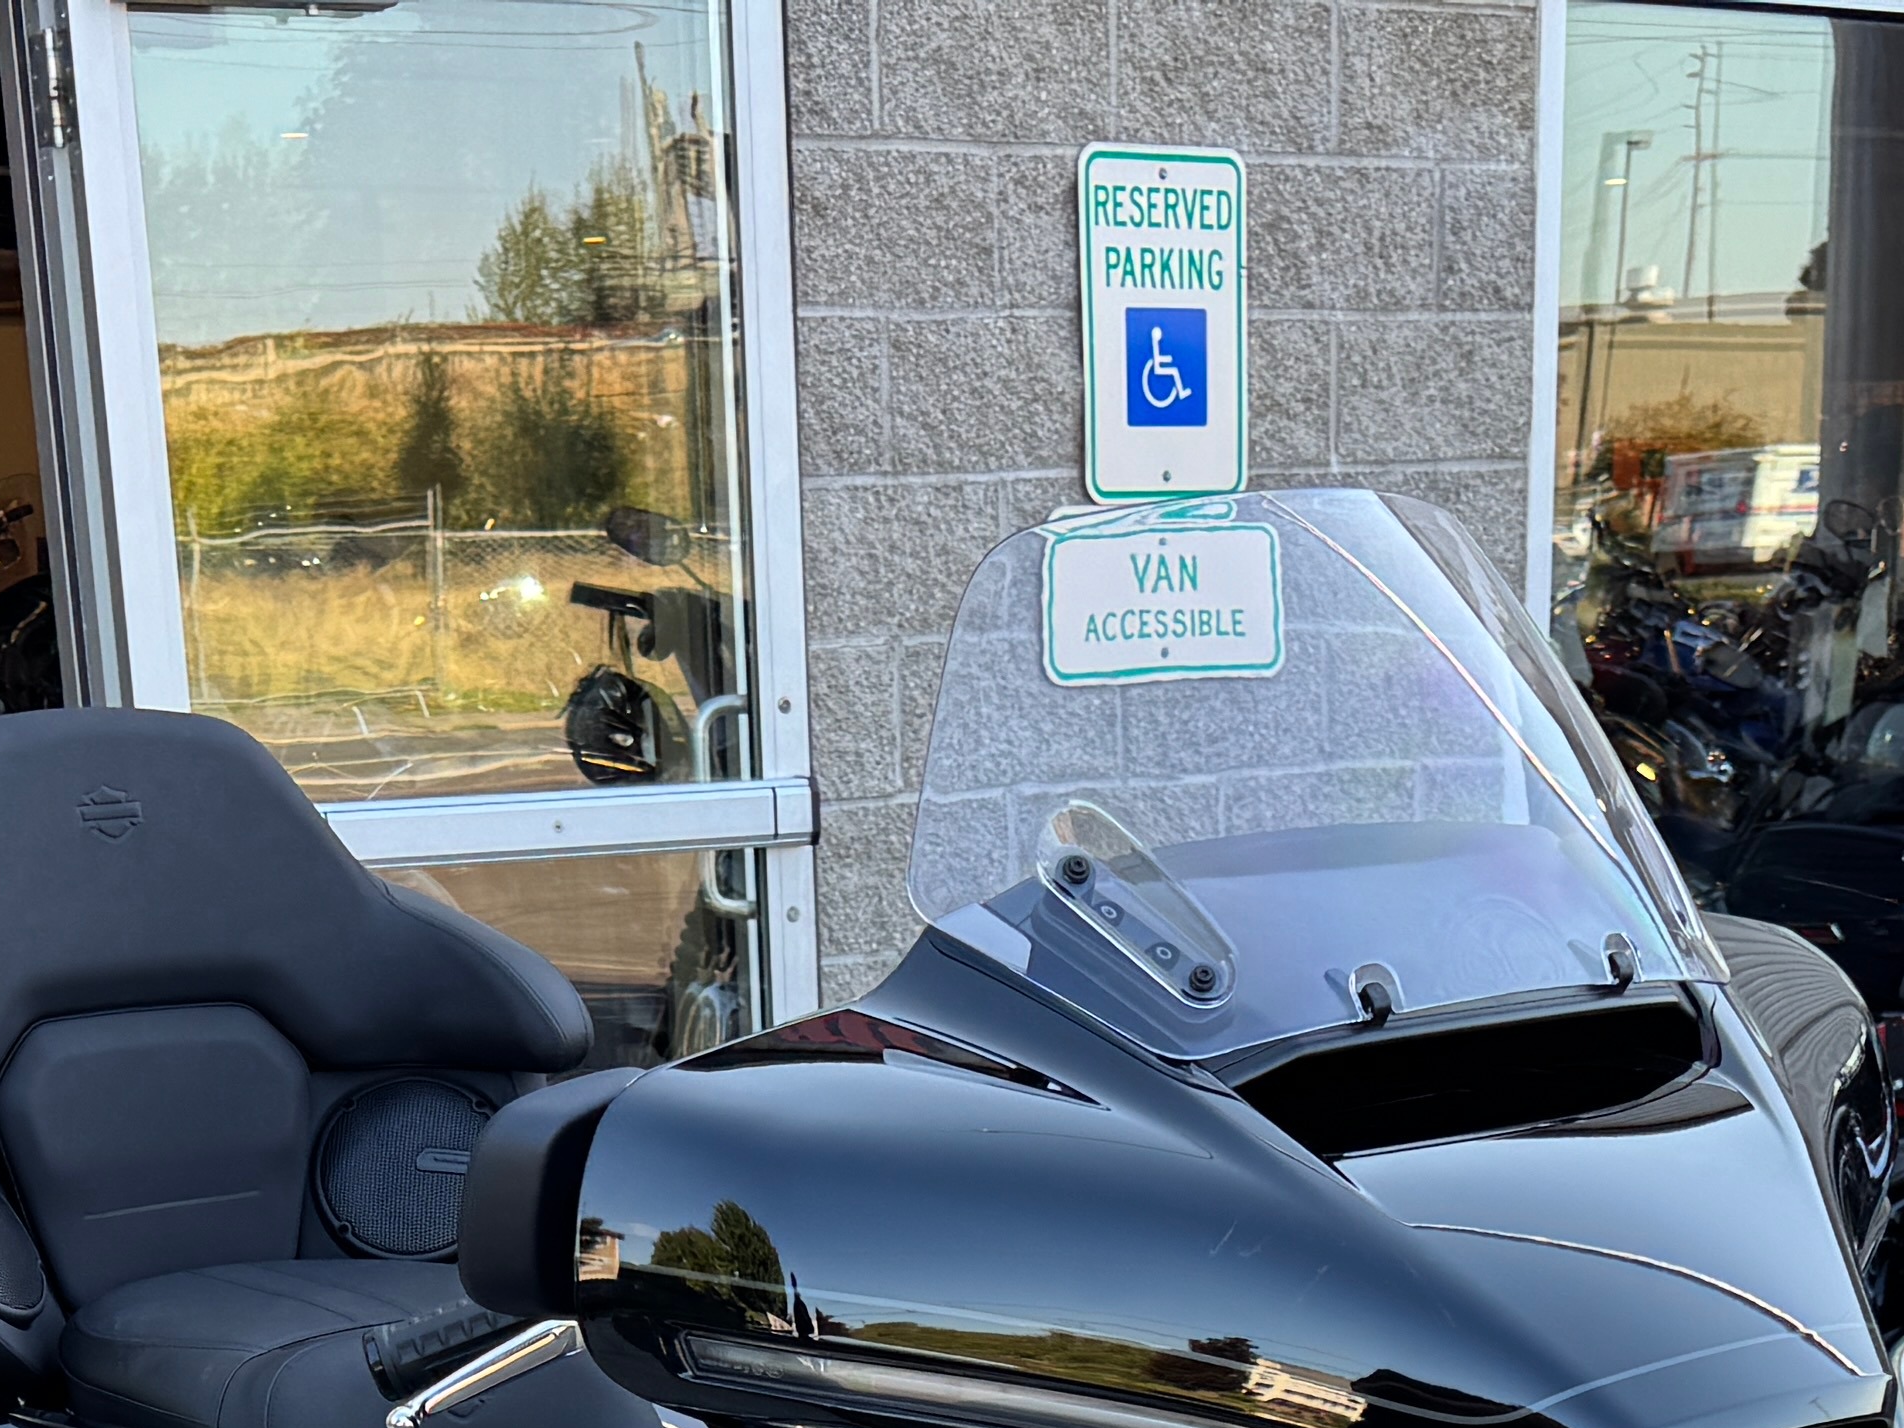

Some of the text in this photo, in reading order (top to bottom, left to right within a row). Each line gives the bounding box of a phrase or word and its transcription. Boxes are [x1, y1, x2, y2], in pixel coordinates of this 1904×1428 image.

[1094, 184, 1233, 231] RESERVED
[1105, 246, 1224, 292] PARKING
[1129, 553, 1199, 594] VAN
[1084, 608, 1247, 643] ACCESSIBLE
